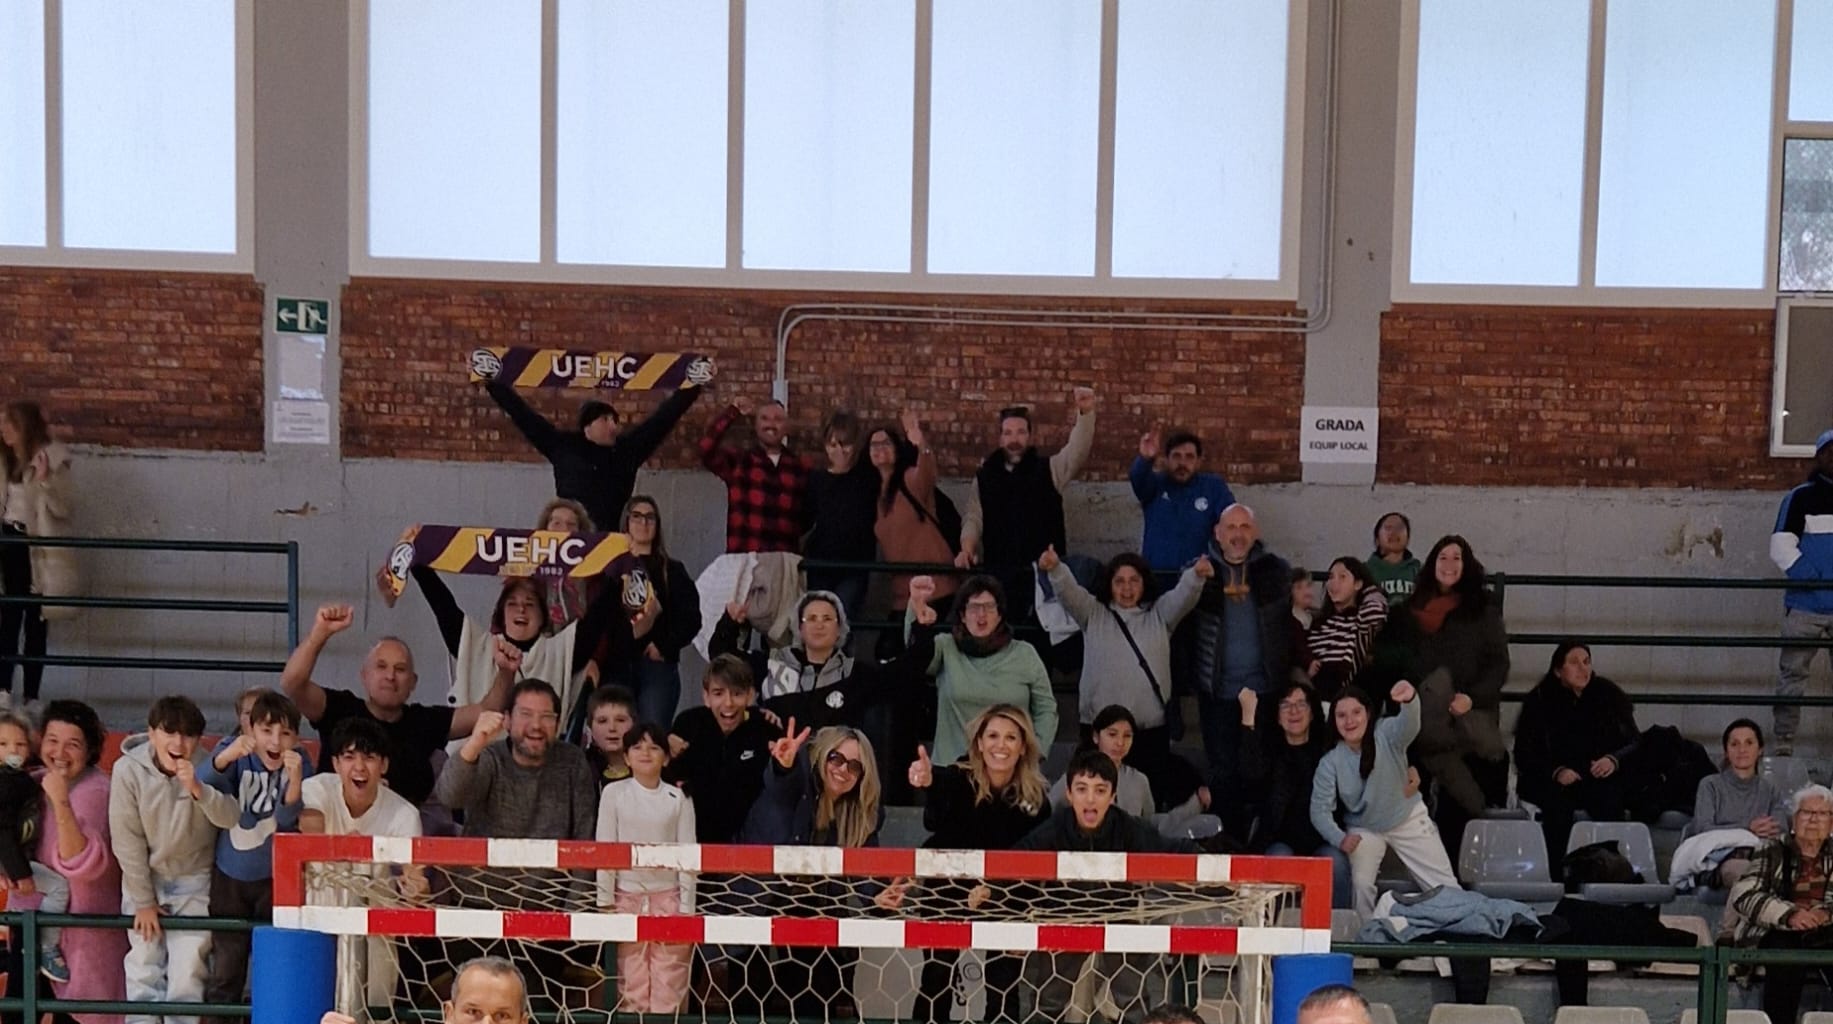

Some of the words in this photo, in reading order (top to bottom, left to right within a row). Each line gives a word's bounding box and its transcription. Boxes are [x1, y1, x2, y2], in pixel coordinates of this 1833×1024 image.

[552, 354, 637, 379] UEHC
[1315, 419, 1365, 431] GRADA
[1309, 441, 1338, 450] EQUIP
[1340, 442, 1368, 450] LOCAL
[476, 534, 586, 566] UEHC
